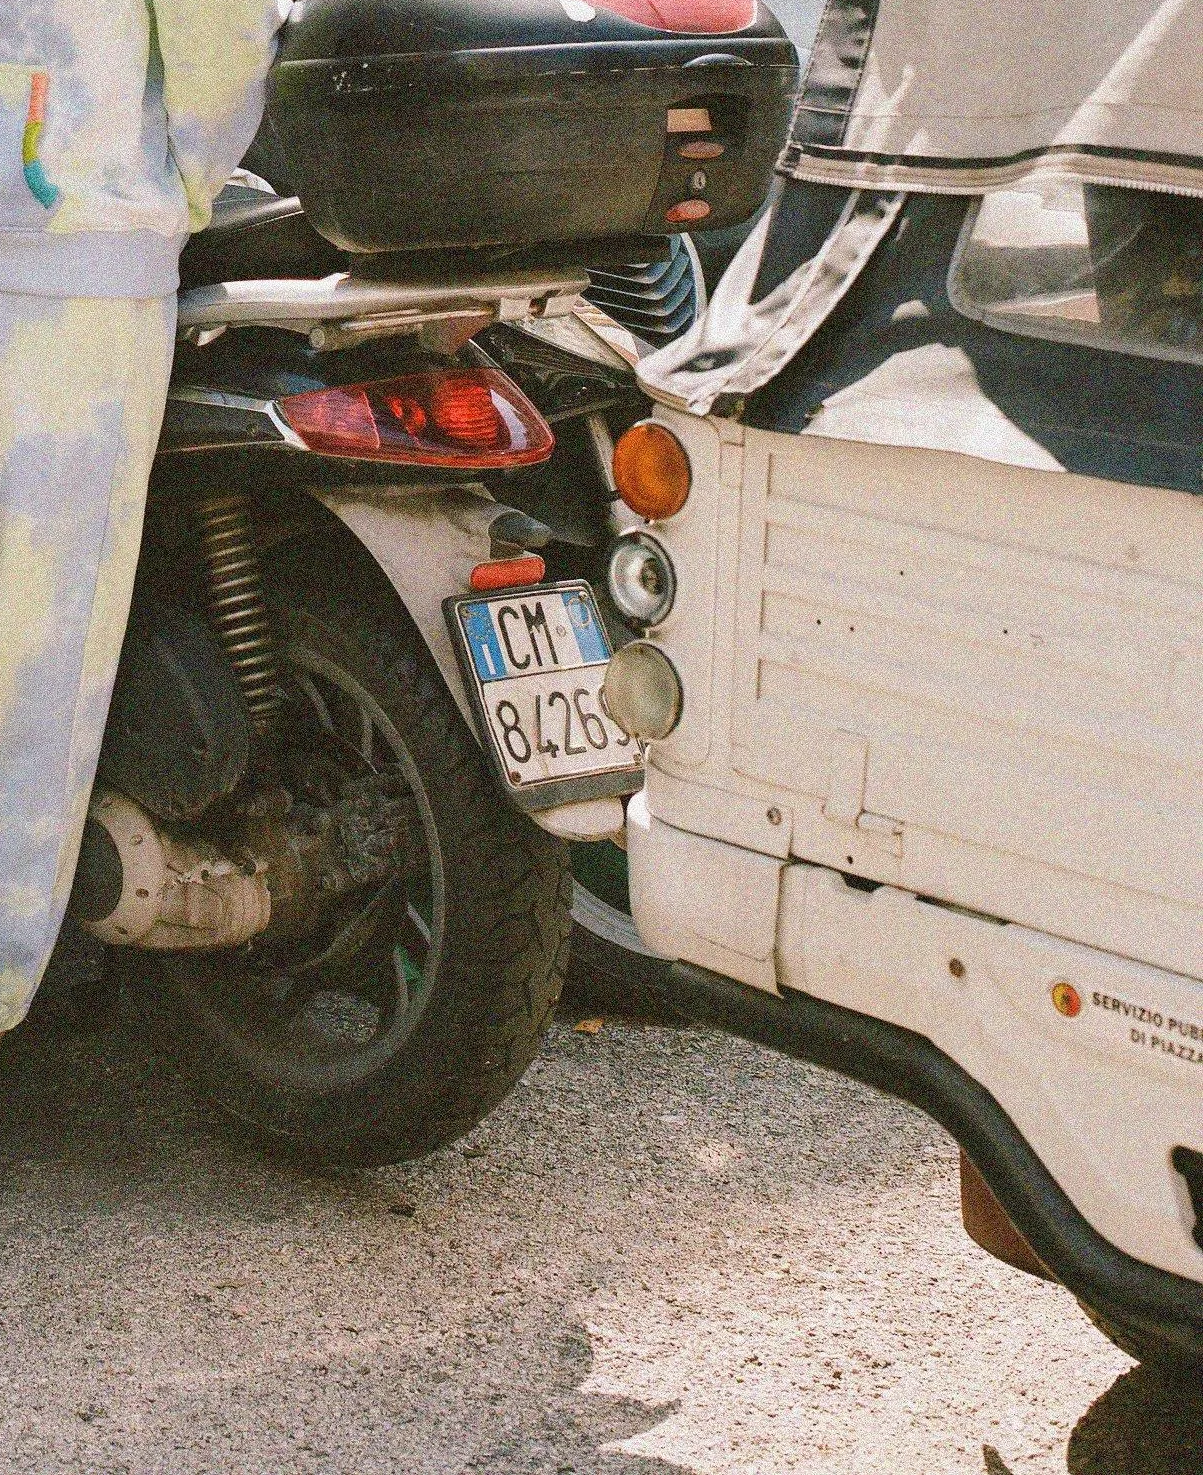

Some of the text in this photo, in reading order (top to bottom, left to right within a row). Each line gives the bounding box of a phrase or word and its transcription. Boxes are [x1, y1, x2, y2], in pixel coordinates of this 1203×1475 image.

[497, 601, 559, 670] CM
[1092, 991, 1163, 1027] SERVIZIO
[1131, 1028, 1146, 1045] DI
